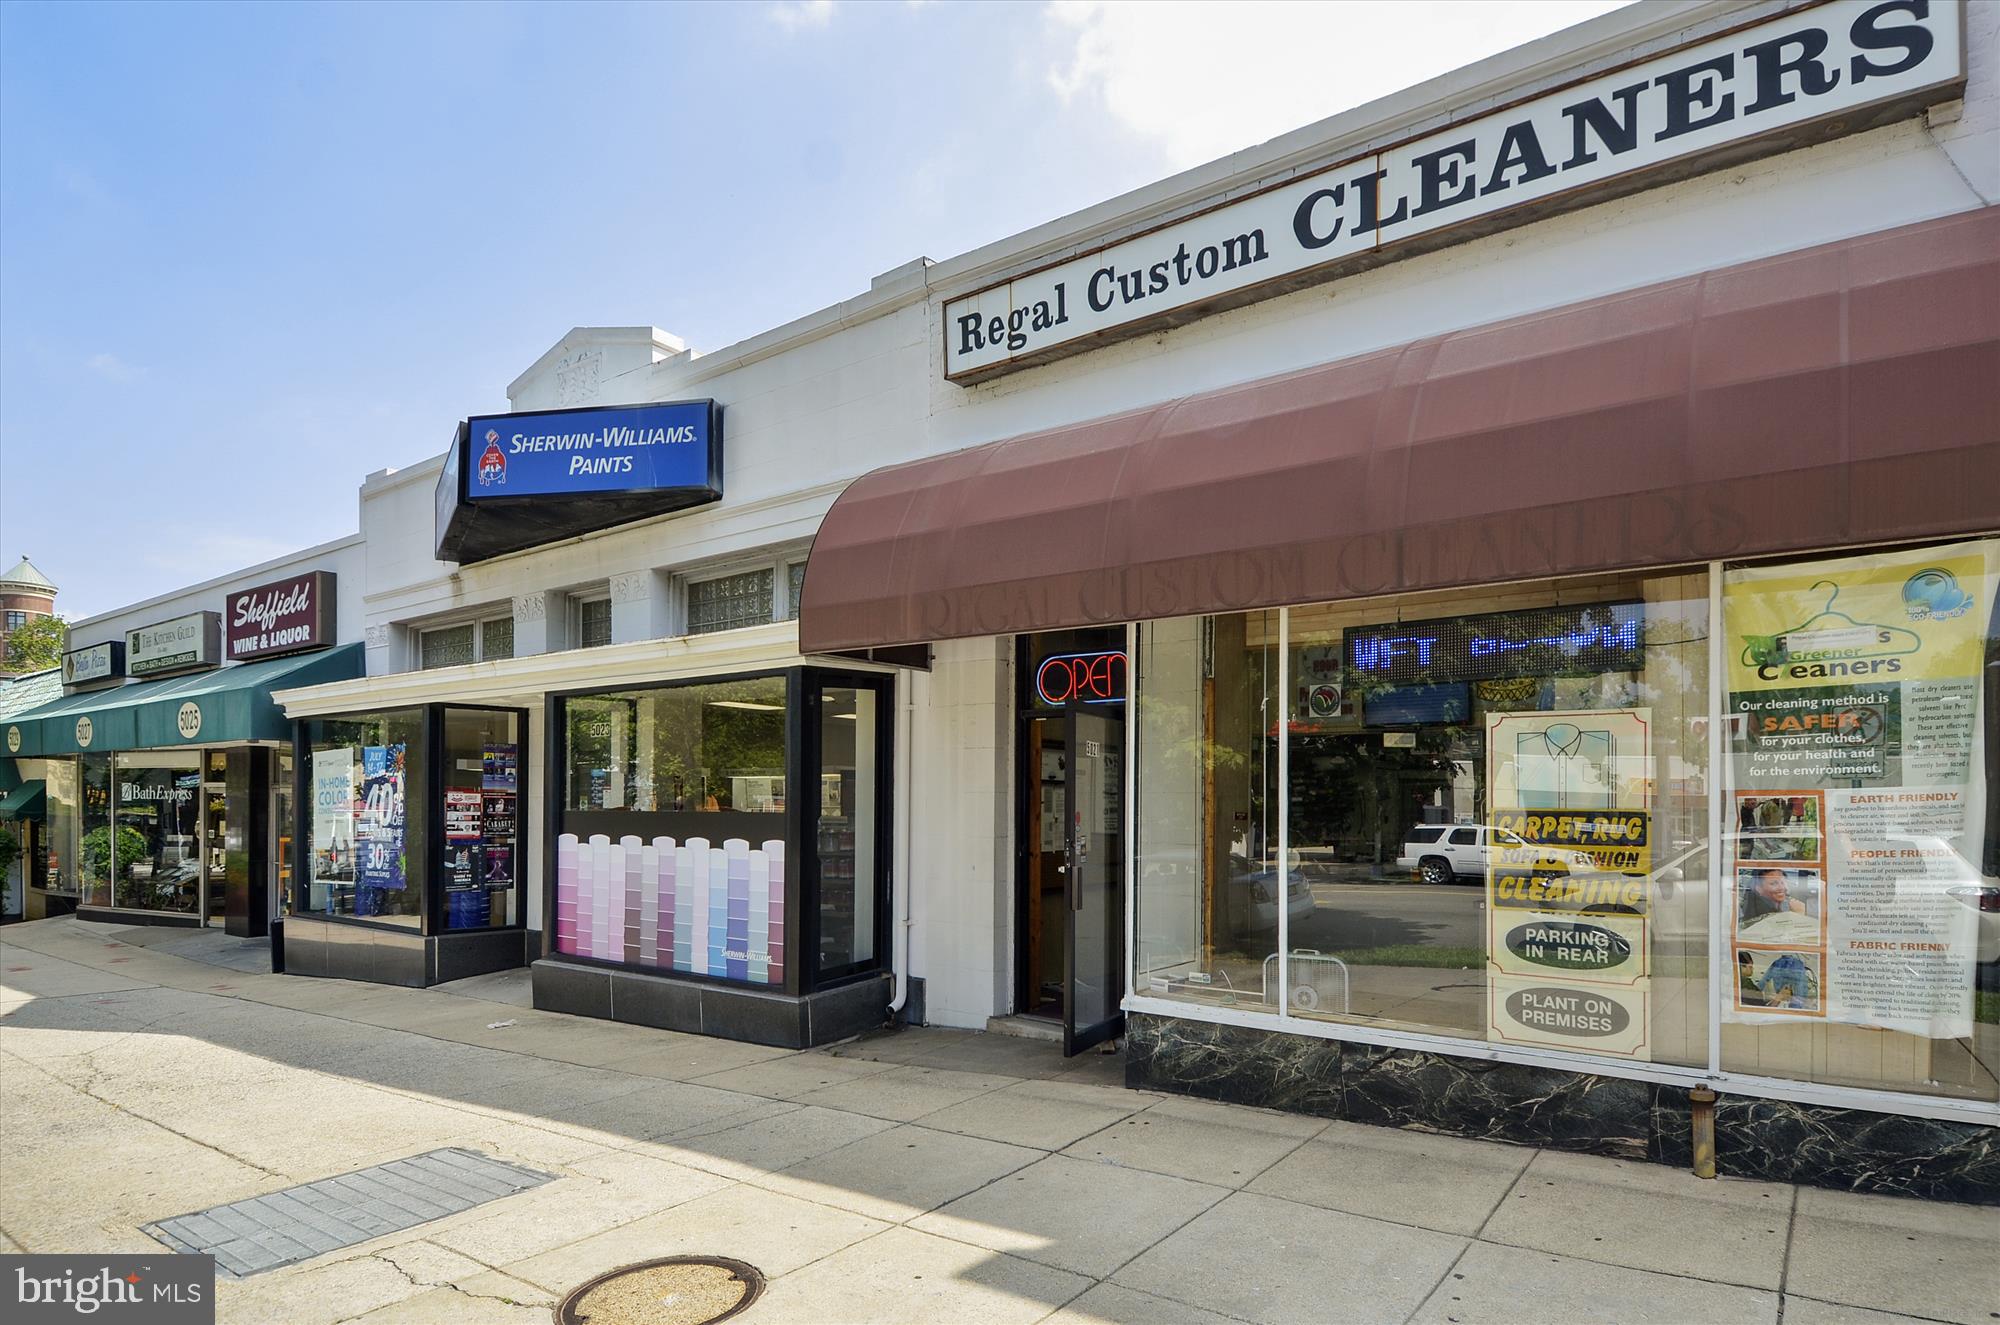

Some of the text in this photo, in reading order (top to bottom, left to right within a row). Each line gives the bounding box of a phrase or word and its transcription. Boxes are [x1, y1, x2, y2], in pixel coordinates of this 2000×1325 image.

[957, 0, 1935, 355] Regal Custom CLEANERS
[510, 425, 695, 454] SHERWIN-WILLIAMS
[569, 455, 633, 475] PAINTS
[234, 582, 310, 631] Sheffield
[233, 625, 310, 654] WINE & LIQUOR
[1790, 647, 1862, 661] Greener
[1040, 654, 1128, 701] OPEN
[1928, 686, 1938, 694] dry
[1740, 694, 1890, 712] Our cleaning method is
[180, 710, 199, 731] 5025
[591, 723, 610, 737] 5023
[1764, 714, 1861, 732] SAFER
[78, 723, 90, 740] 5027
[1762, 733, 1866, 749] for your clothes,
[1754, 748, 1876, 765] for your health and
[1750, 766, 1768, 776] for
[1770, 766, 1791, 776] the
[1794, 764, 1882, 776] environment.
[133, 785, 193, 803] BathExpress
[1850, 792, 1958, 804] EARTH FRIENDLY
[365, 782, 394, 827] 40
[1497, 815, 1642, 843] CARPET, RUG
[368, 843, 385, 870] 30
[1565, 851, 1640, 867] CSHION
[1852, 849, 1957, 859] PEOPLE FRIENDL
[1498, 876, 1642, 906] CLEANING
[1525, 928, 1610, 948] PARKING
[1850, 940, 1951, 952] FABRIC FRIENY
[720, 948, 772, 962] SHERWIN-WILLIAMS
[1525, 944, 1609, 964] IN REAR
[1522, 993, 1612, 1015] PLANT ON
[1522, 1010, 1612, 1032] PREMISES
